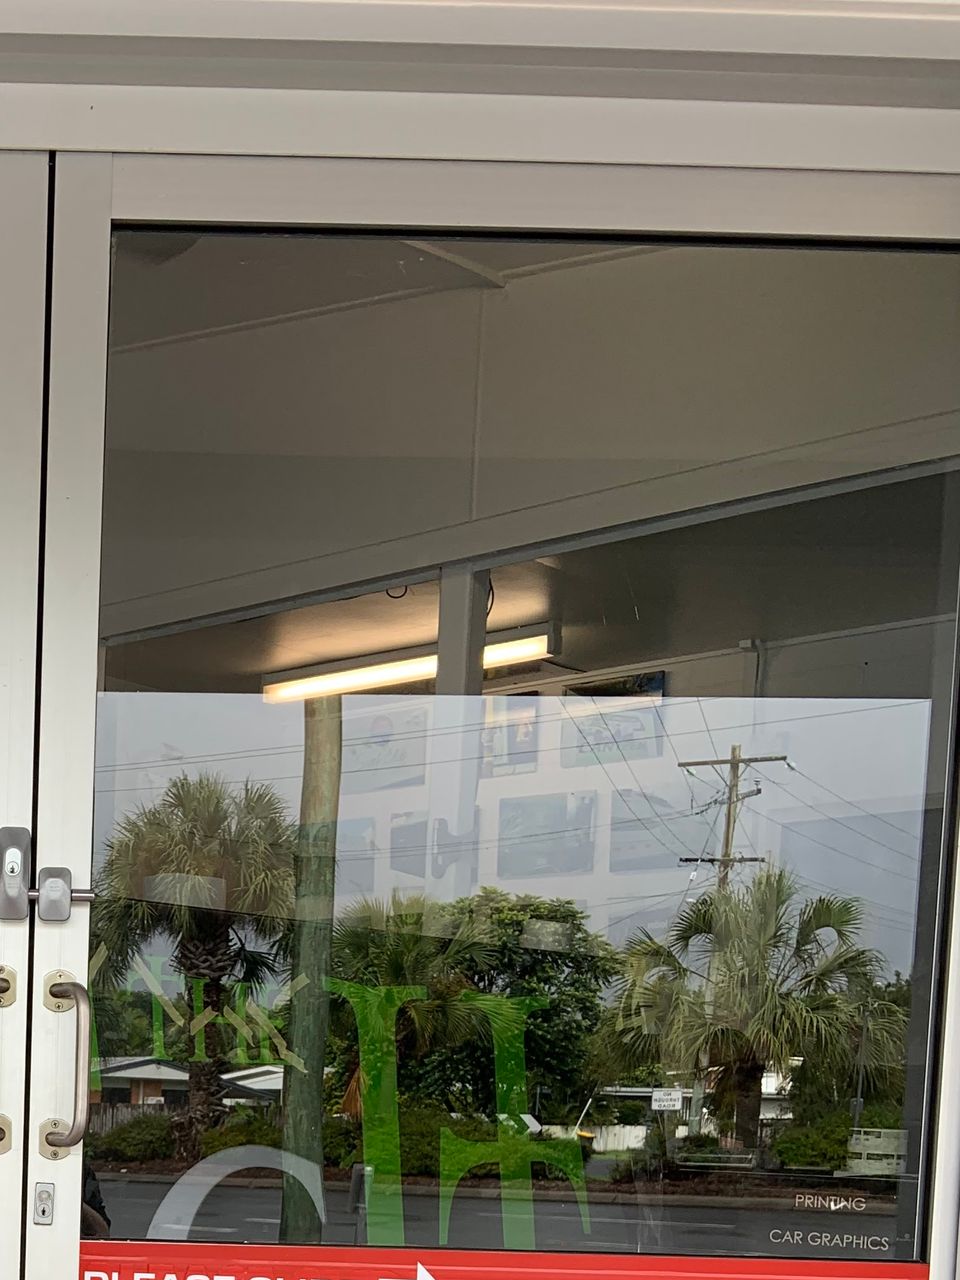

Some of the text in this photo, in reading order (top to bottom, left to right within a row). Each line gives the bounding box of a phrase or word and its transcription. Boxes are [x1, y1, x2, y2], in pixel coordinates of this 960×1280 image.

[795, 1194, 867, 1211] PRINTING
[769, 1229, 889, 1251] CAR GRAPHICS
